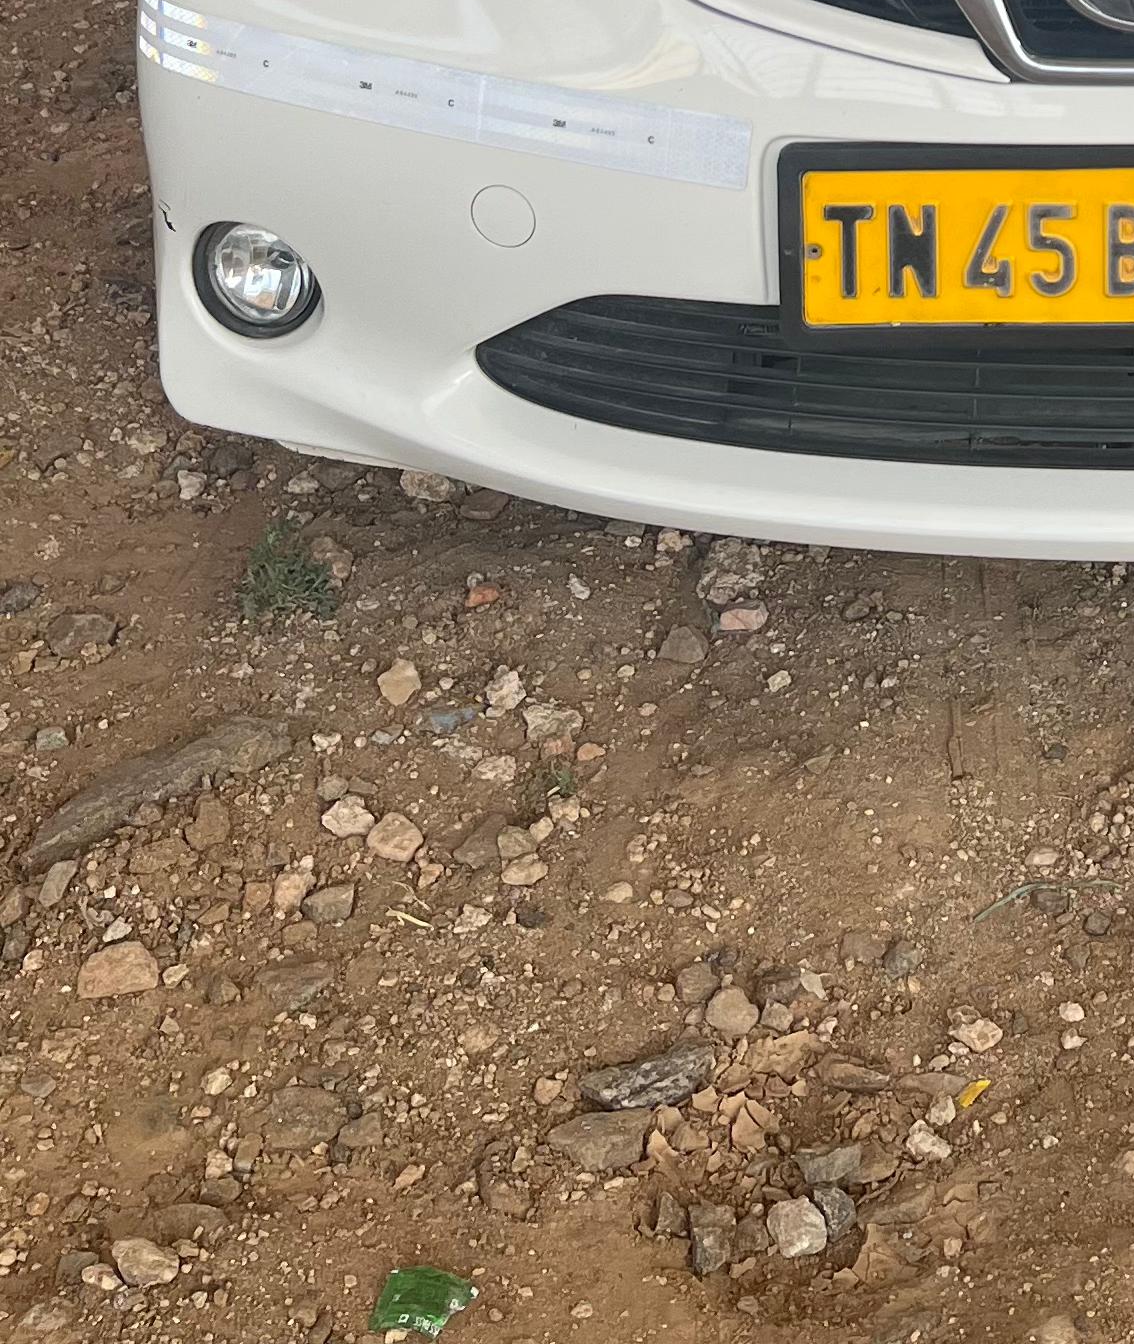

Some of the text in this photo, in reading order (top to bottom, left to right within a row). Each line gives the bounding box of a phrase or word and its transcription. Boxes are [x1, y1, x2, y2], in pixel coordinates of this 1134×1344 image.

[359, 80, 455, 107] 3M C
[648, 135, 655, 144] C
[824, 204, 937, 299] TN
[964, 202, 1077, 298] 45
